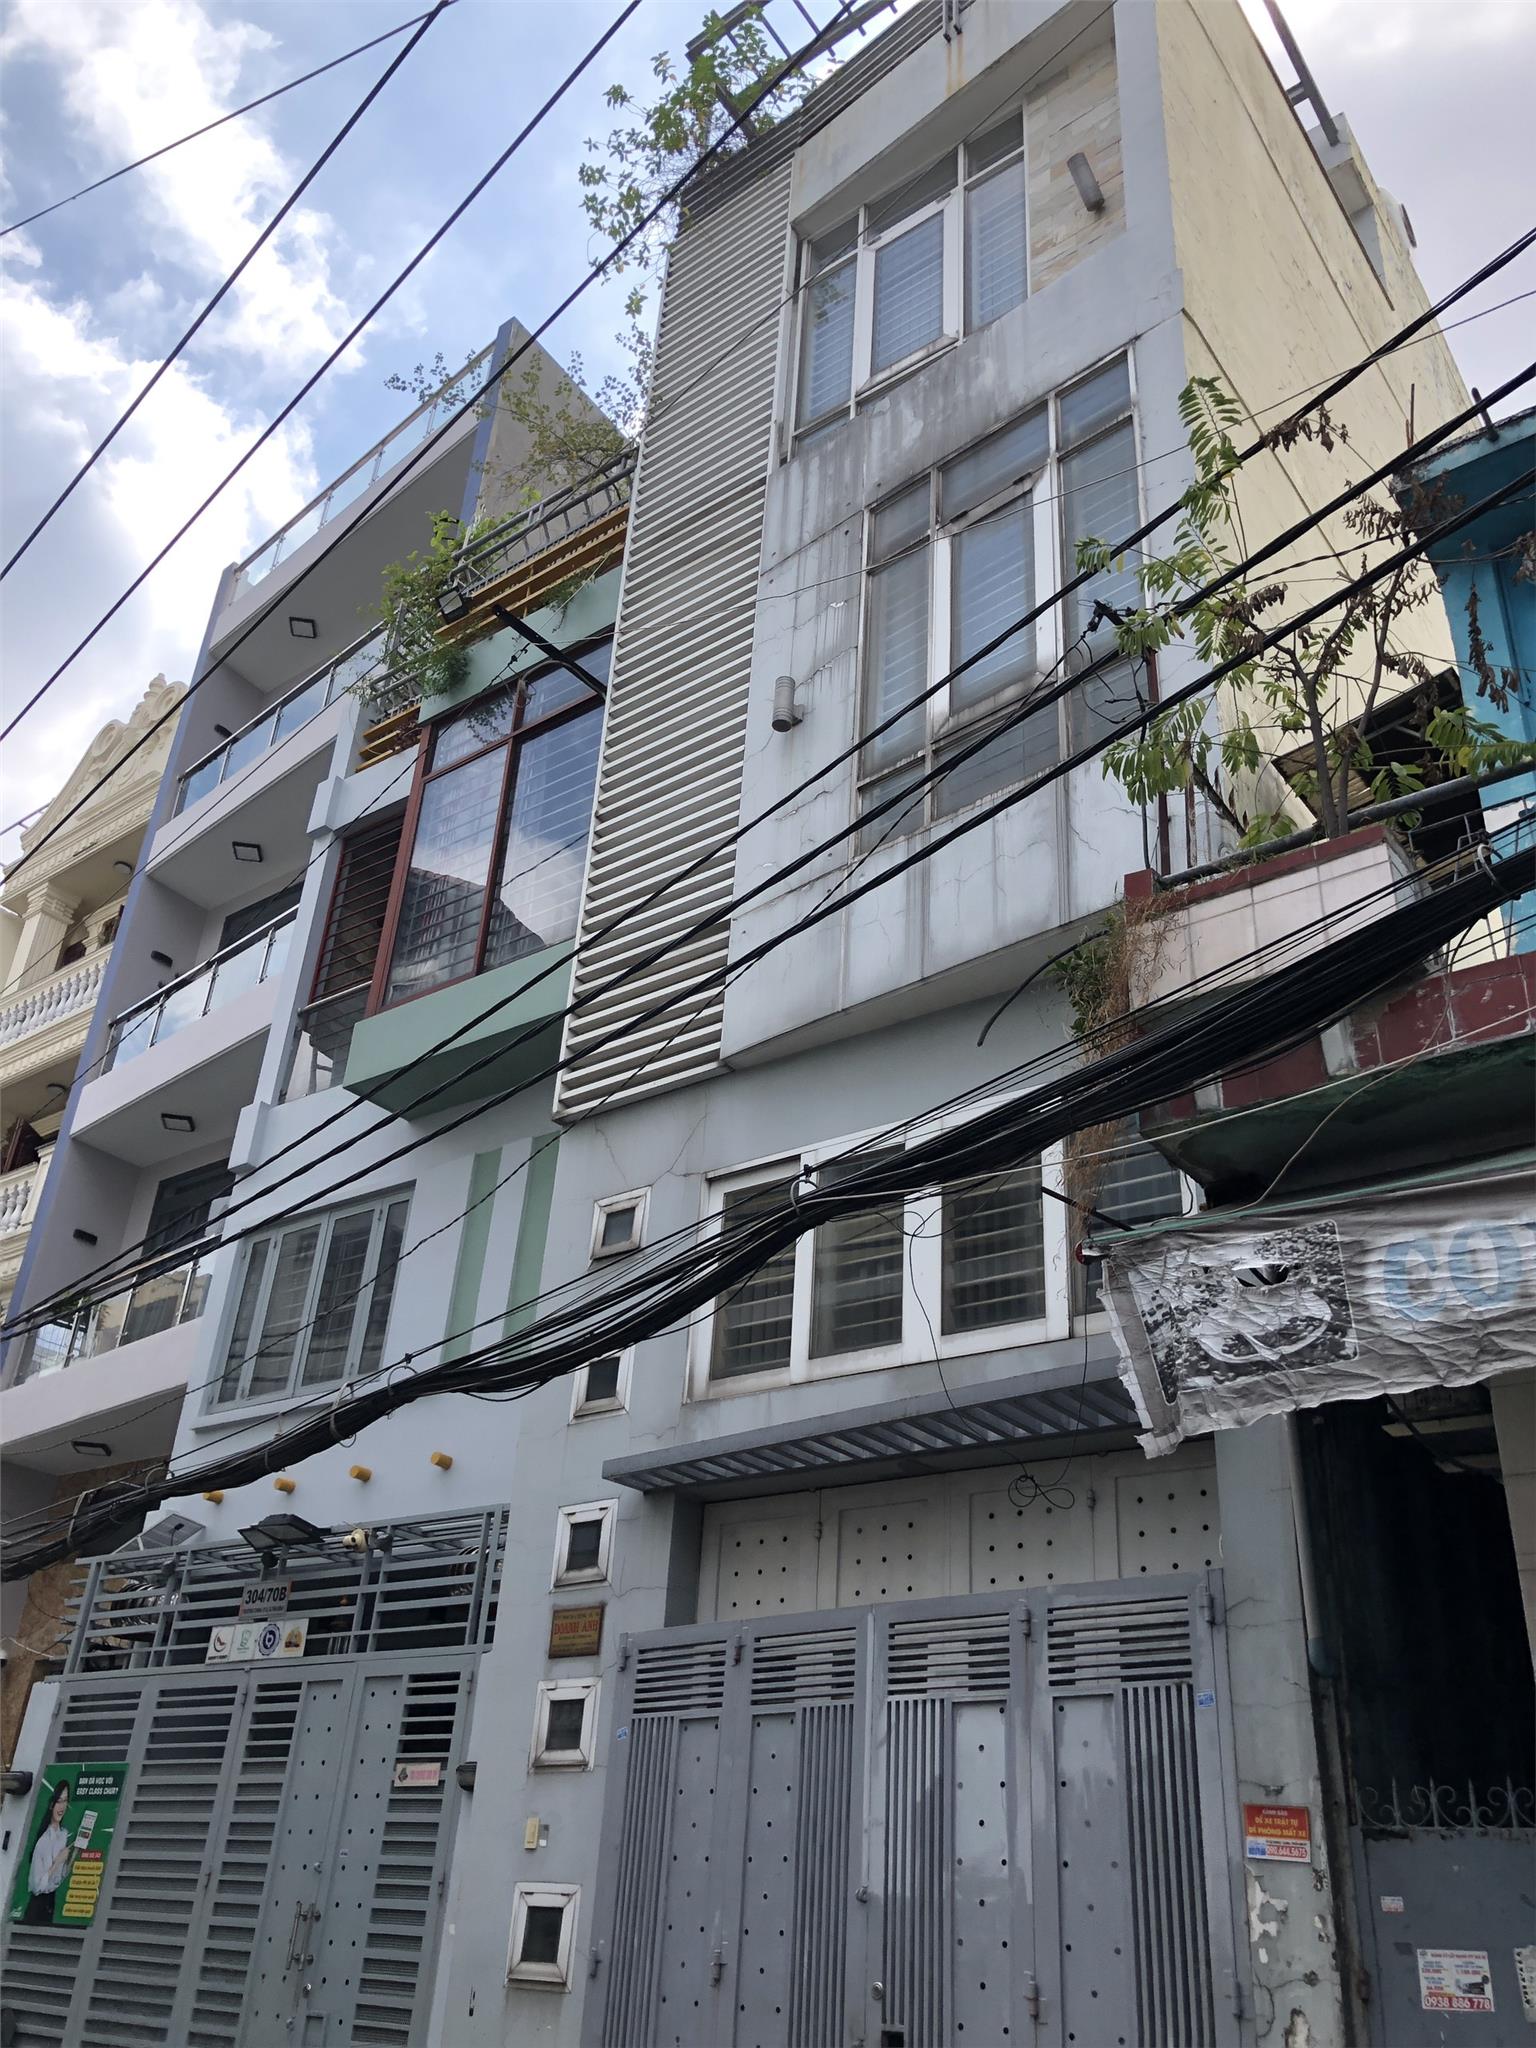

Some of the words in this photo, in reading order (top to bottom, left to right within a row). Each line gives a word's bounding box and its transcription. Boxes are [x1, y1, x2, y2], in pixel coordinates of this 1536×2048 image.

[1383, 1221, 1536, 1321] CO
[245, 1587, 287, 1604] 304/70B
[1424, 1996, 1450, 2008] 0938
[1472, 1998, 1491, 2010] 778
